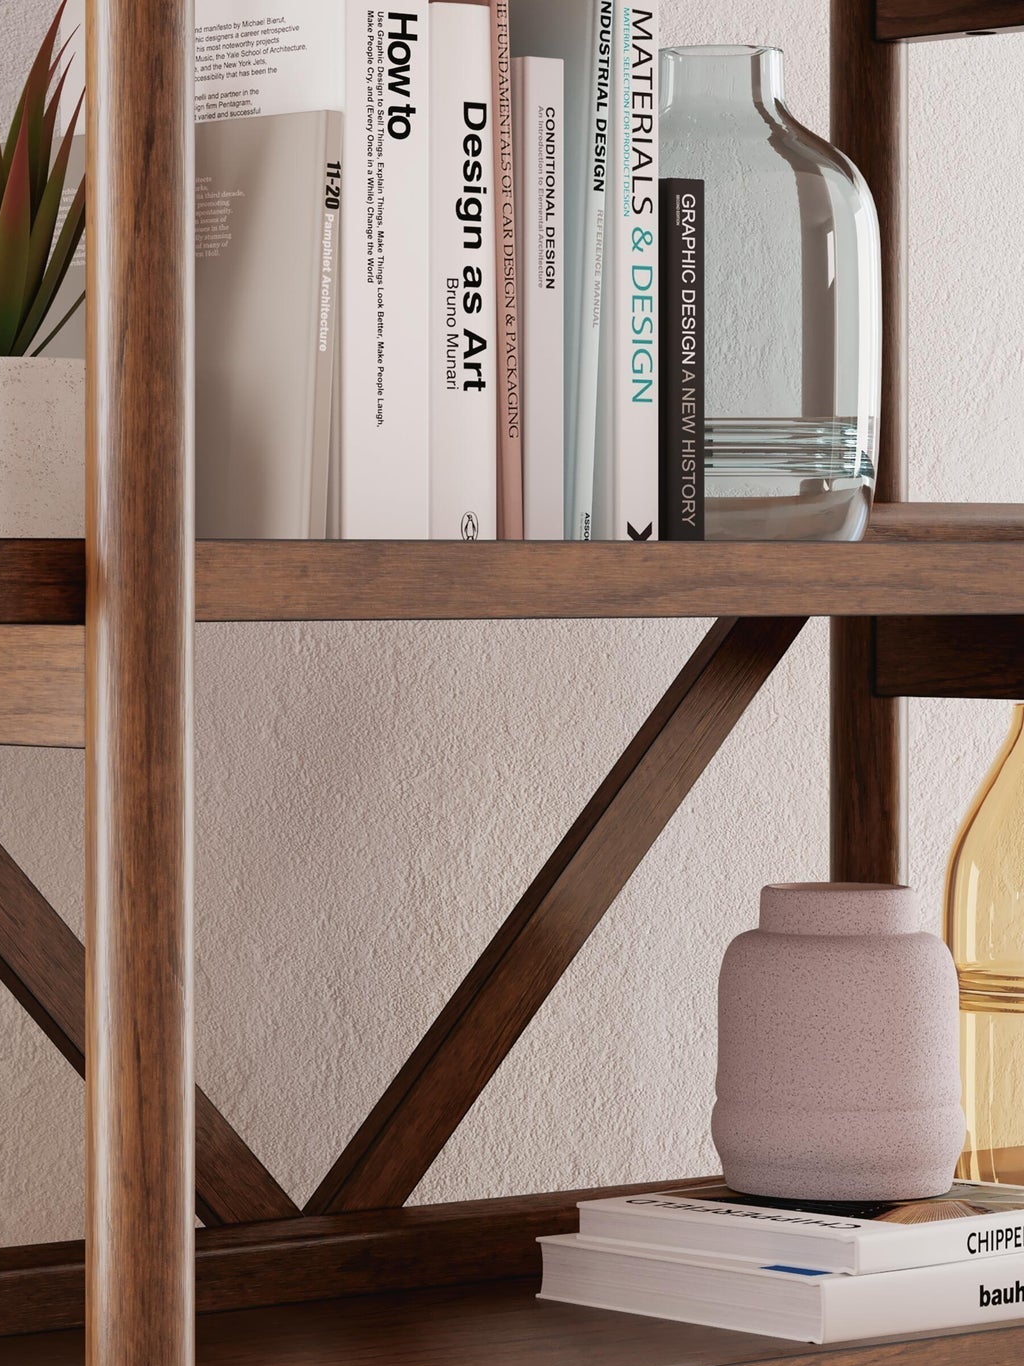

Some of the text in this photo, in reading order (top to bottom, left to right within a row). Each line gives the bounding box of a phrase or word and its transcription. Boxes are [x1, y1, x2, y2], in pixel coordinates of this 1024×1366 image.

[204, 24, 232, 32] manifesto
[205, 33, 233, 42] designers
[261, 25, 299, 35] retrospective
[222, 41, 254, 50] noteworthy
[256, 38, 279, 46] projects
[241, 49, 261, 57] School
[366, 35, 374, 65] People
[376, 30, 384, 64] Graphic
[366, 67, 374, 84] Cry,
[376, 66, 384, 96] Design
[387, 12, 418, 140] How to
[378, 98, 384, 107] to
[497, 23, 512, 171] FUNDAMENTALS
[593, 1, 612, 192] NDUSTRIAL DESIGN
[198, 111, 216, 120] varied
[230, 107, 261, 116] successful
[366, 104, 374, 133] (Every
[538, 106, 544, 118] An
[376, 129, 384, 159] Things,
[366, 177, 374, 205] While)
[376, 162, 384, 194] Explain
[502, 175, 512, 198] OF
[538, 177, 544, 186] to
[376, 197, 384, 228] Things,
[546, 107, 555, 290] CONDITIONAL DESIGN
[632, 9, 653, 403] MATERIALS & DESIGN
[366, 206, 374, 240] Change
[503, 203, 513, 239] CAR
[319, 161, 341, 352] 11-20 Pamphlet Architecture
[456, 101, 487, 391] Design as Art
[376, 256, 384, 285] Things
[504, 244, 516, 308] DESIGN
[593, 210, 604, 328] REFERENCE MANUAL
[446, 278, 459, 391] Bruno Munari
[506, 314, 515, 327] &
[681, 193, 696, 527] GRAPHIC DESIGN A NEW HISTORY
[376, 367, 384, 396] People
[506, 332, 519, 440] PACKAGING
[376, 398, 384, 428] Laugh,
[966, 1226, 1024, 1254] CHIPPE
